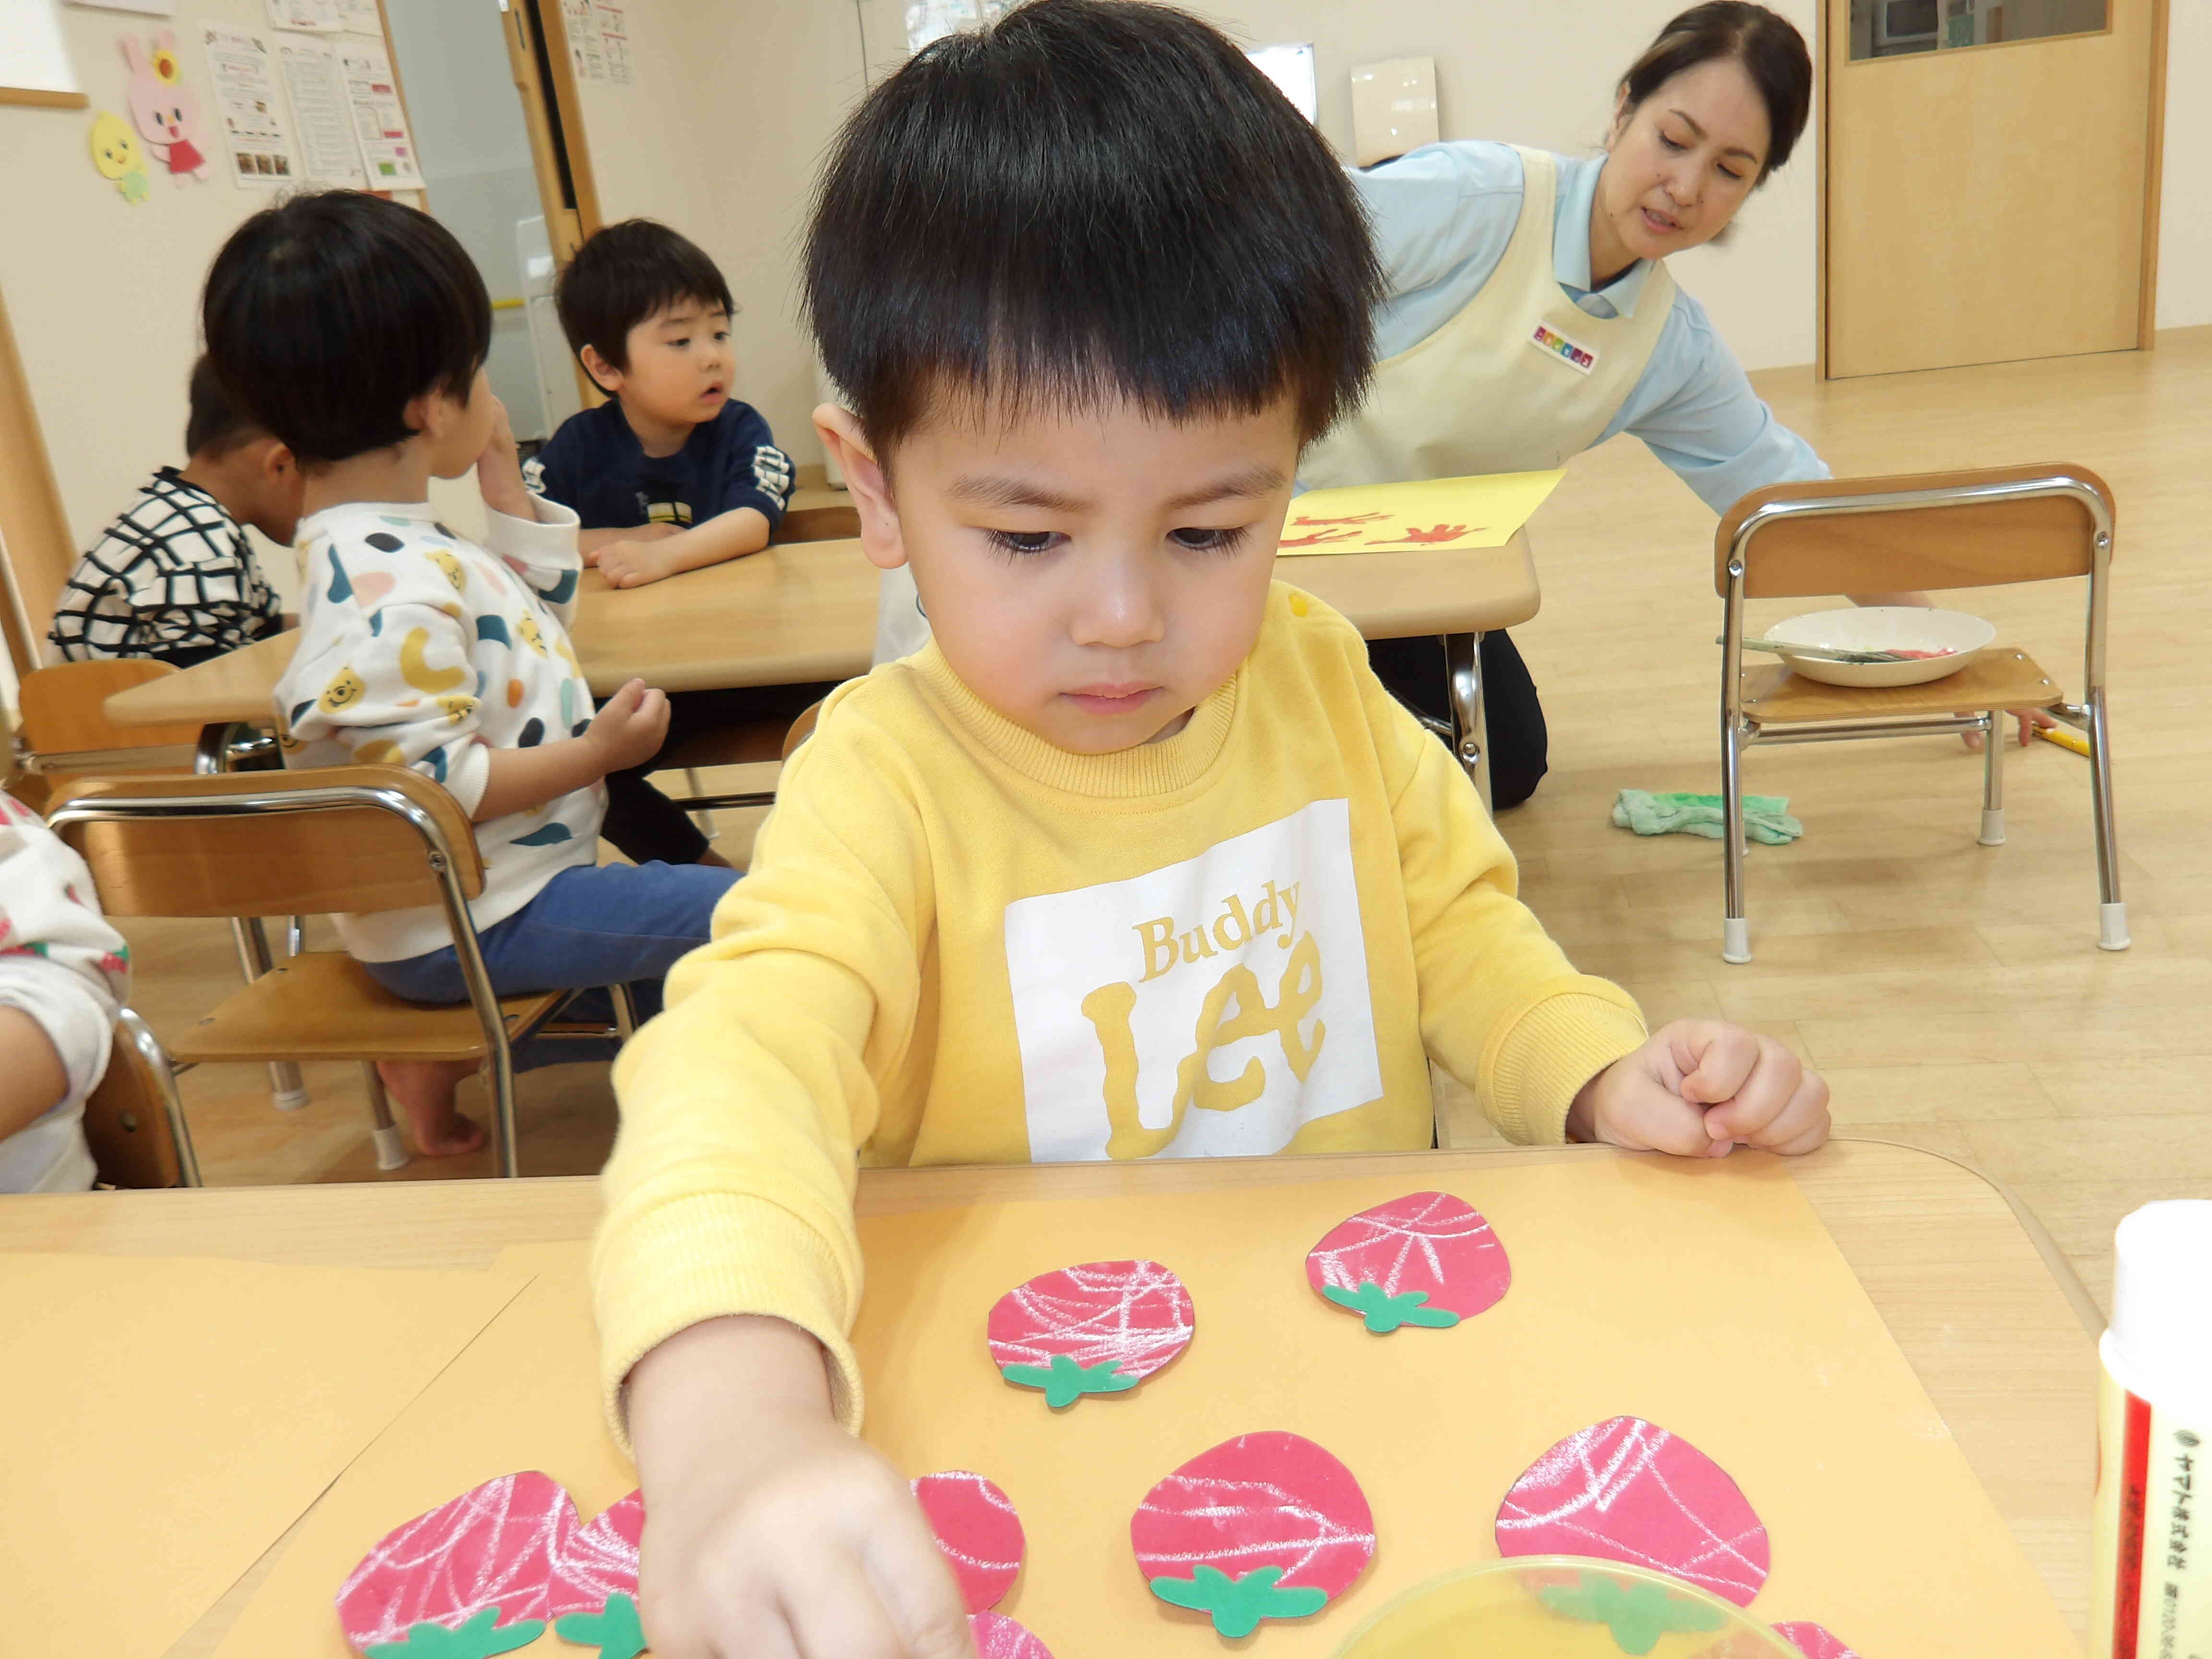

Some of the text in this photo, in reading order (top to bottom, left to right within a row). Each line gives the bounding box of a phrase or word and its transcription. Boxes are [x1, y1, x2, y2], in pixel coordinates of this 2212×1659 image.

[1132, 879, 1300, 983] Buddy
[1081, 930, 1326, 1160] Lee
[2167, 1454, 2194, 1570] ヤマト株式会社
